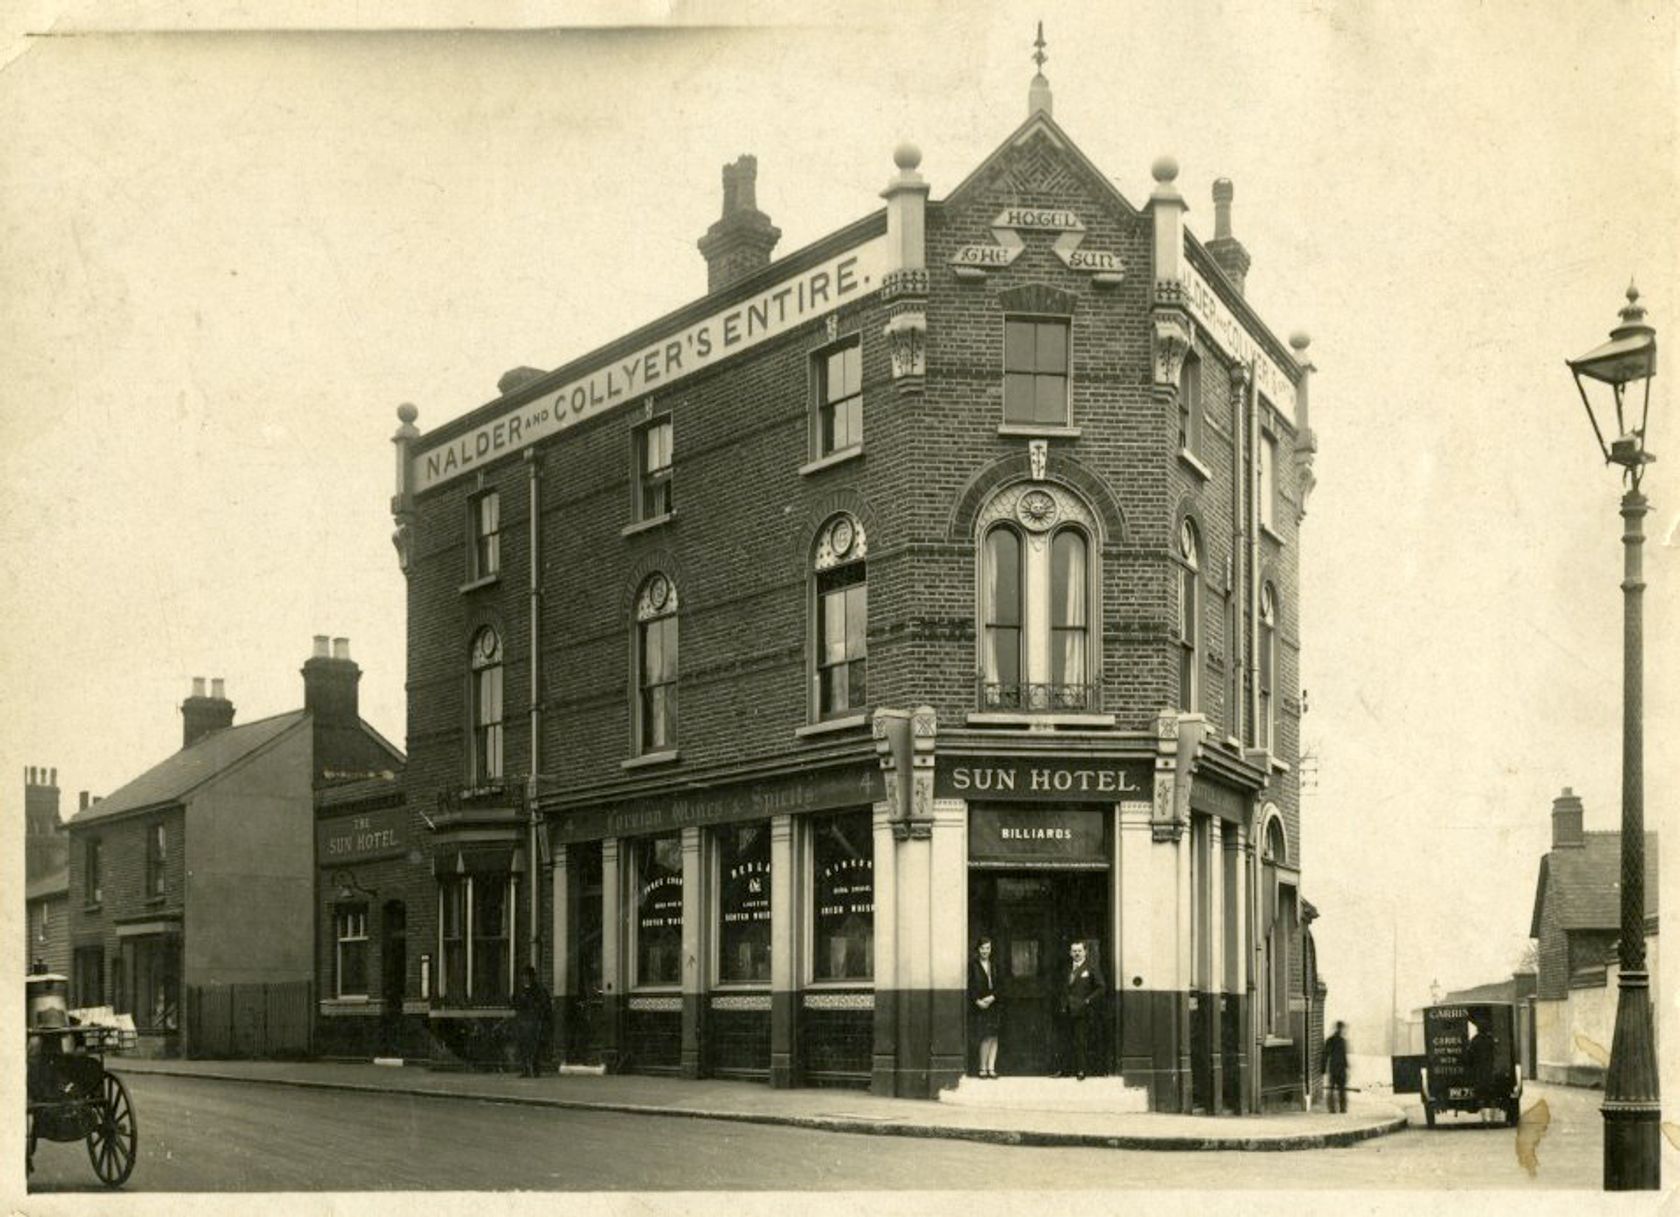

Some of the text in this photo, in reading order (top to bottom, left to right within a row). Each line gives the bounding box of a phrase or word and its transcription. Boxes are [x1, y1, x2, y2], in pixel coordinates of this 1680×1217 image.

[1069, 250, 1114, 269] SUN
[427, 256, 871, 481] NALDER AND COLLYER'S ENTIRE.
[952, 767, 1141, 792] SUN HOTEL.
[353, 817, 370, 830] THE
[1002, 828, 1072, 839] BILLIARDS
[328, 829, 397, 855] SUN HOTEL
